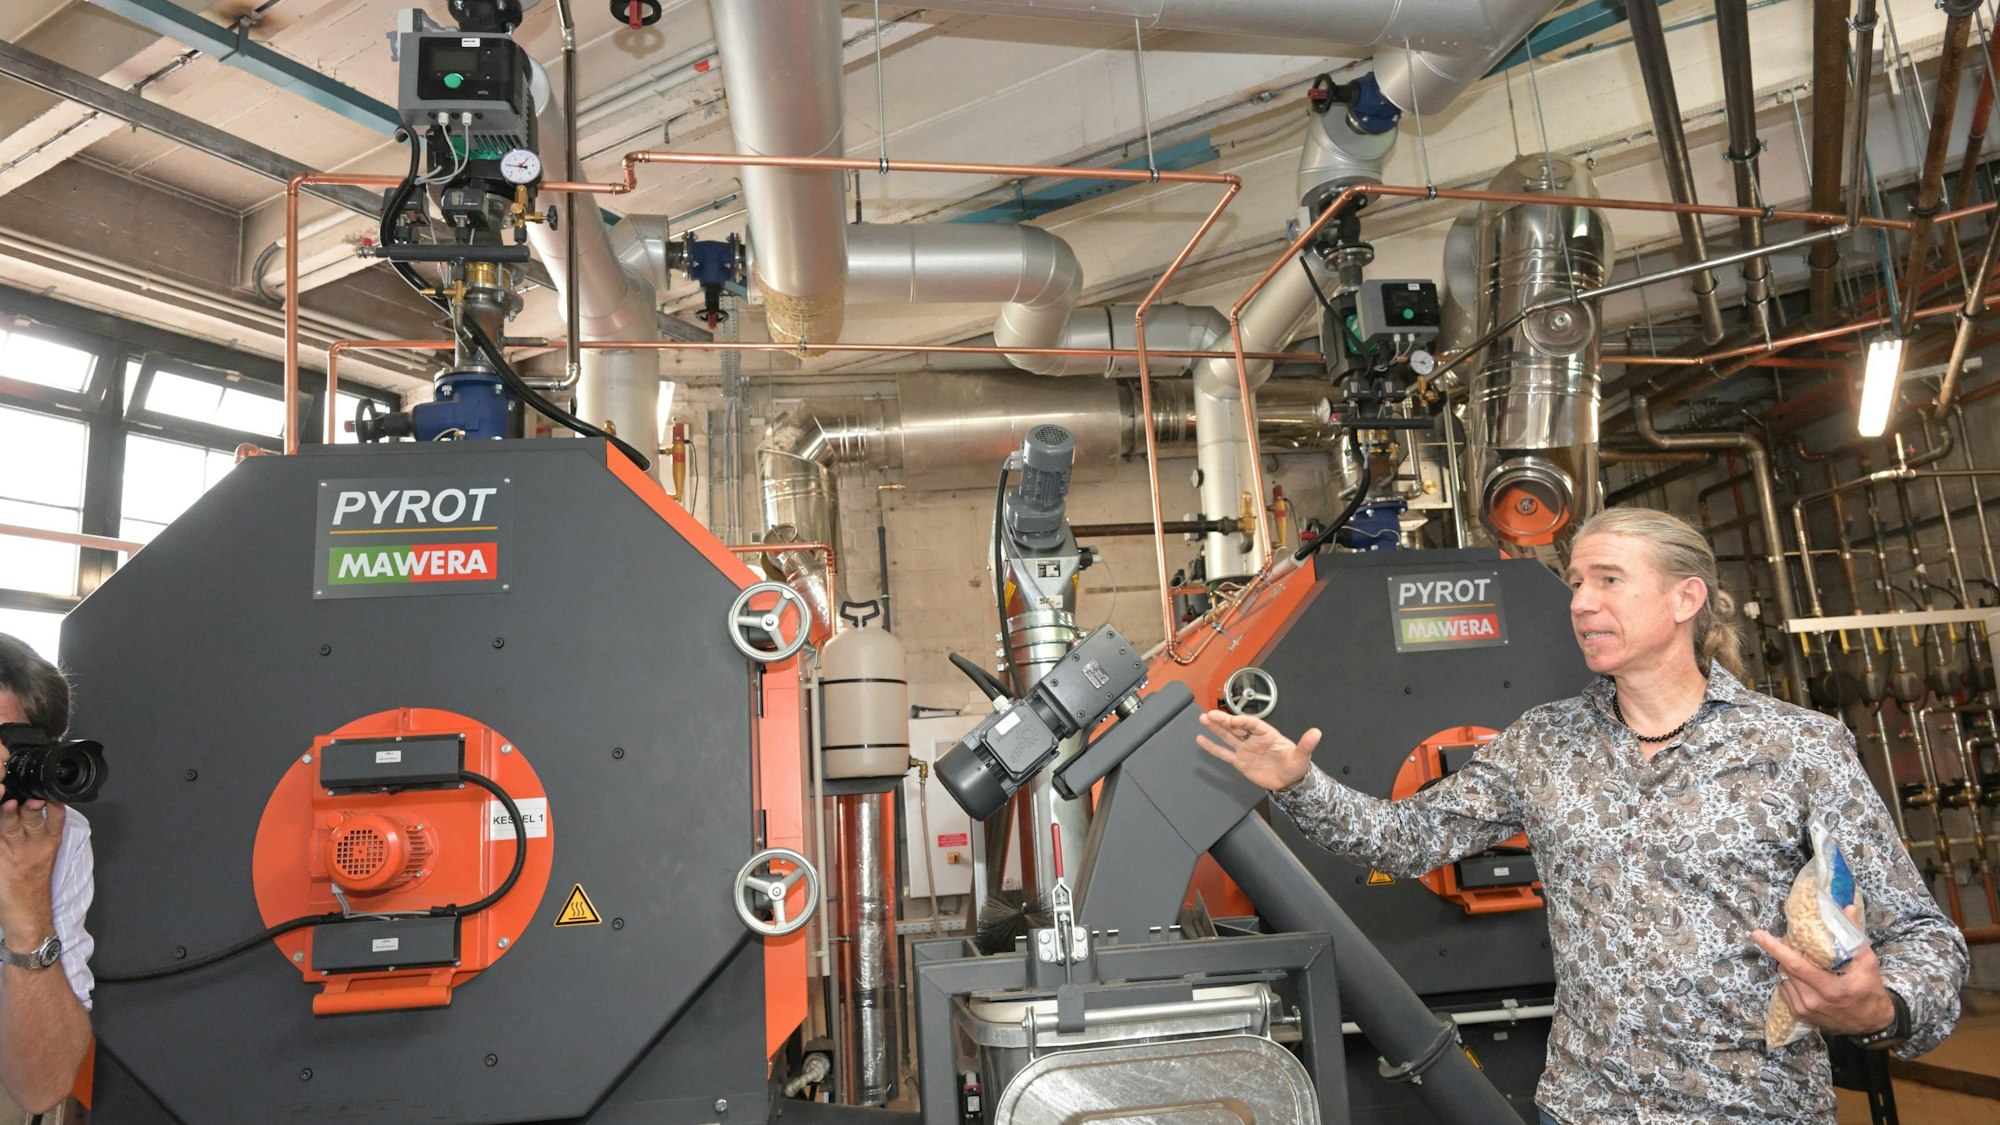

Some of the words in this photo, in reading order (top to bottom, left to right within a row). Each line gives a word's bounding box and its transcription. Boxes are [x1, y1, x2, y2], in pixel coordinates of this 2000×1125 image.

[332, 488, 497, 525] PYROT
[338, 549, 488, 578] MAWERA
[1399, 579, 1491, 605] PYROT
[1408, 618, 1495, 639] MAWERA
[493, 814, 535, 825] KESEL
[539, 814, 544, 822] 1
